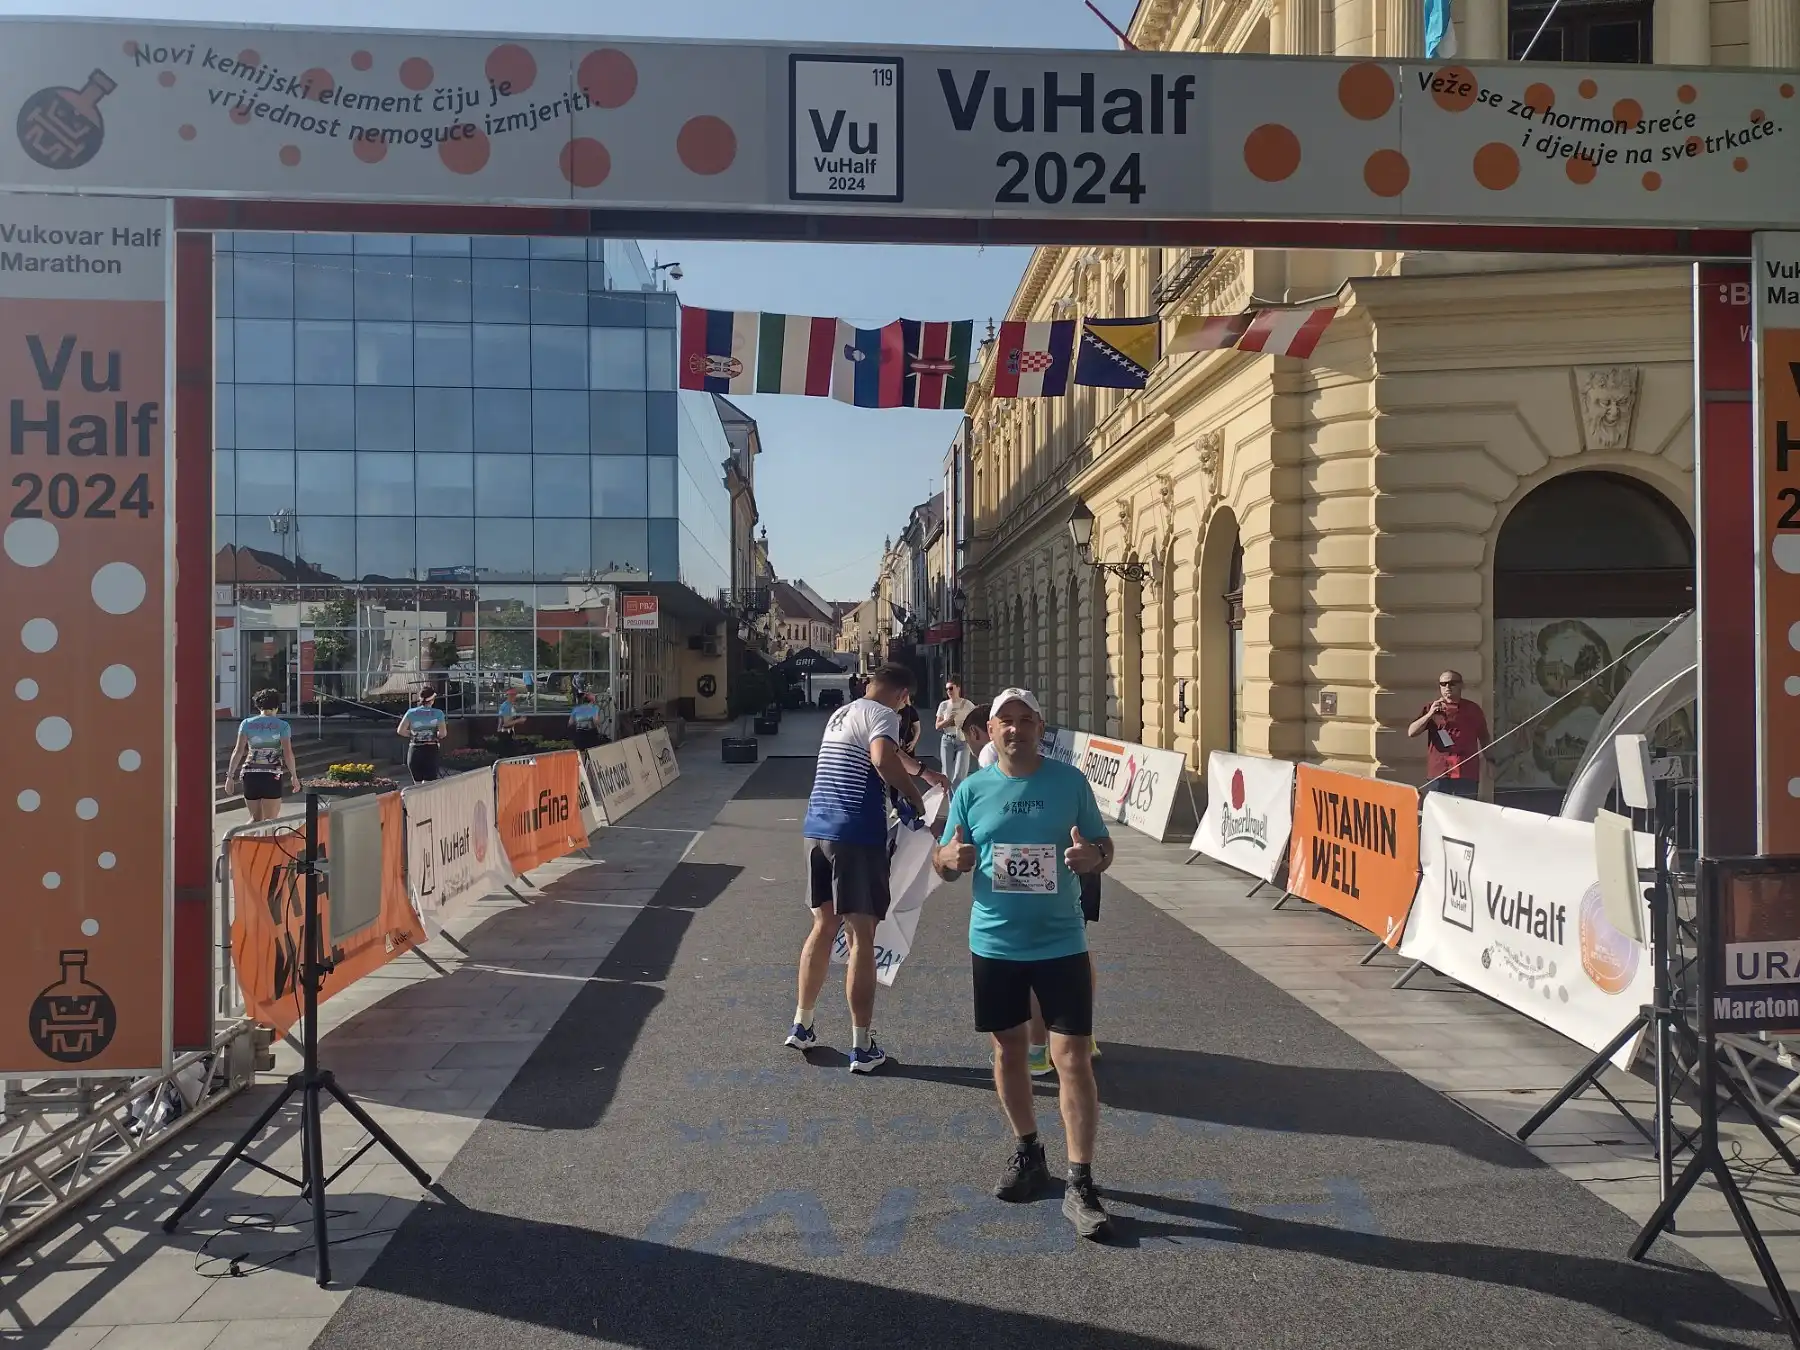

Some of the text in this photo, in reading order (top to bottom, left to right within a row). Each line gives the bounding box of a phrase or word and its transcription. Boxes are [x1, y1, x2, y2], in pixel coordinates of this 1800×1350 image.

[134, 43, 513, 118] Novi kemijski element čiju je
[872, 68, 893, 87] 119
[207, 86, 600, 149] vrijednost nemoguće izmjeriti.
[937, 68, 1196, 135] VuHalf
[1418, 71, 1697, 135] Veže se za hormon sreće
[808, 109, 878, 155] Vu
[1521, 117, 1784, 167] i djeluje na sve trkače.
[814, 157, 877, 175] VuHalf
[828, 176, 866, 191] 2024
[995, 151, 1147, 205] 2024
[0, 223, 162, 247] Vukovar Half
[0, 252, 122, 274] Marathon
[25, 334, 121, 393] Vu
[10, 399, 159, 457] Half
[10, 472, 155, 519] 2024
[795, 658, 817, 667] GRIF
[538, 788, 569, 829] Fina
[1311, 788, 1397, 860] VITAMIN
[440, 827, 470, 866] VuHalf
[1007, 859, 1041, 877] 623
[1311, 835, 1360, 900] WELL
[1450, 868, 1467, 900] Vu
[1487, 881, 1566, 946] VuHalf
[1736, 951, 1800, 981] UR
[1713, 997, 1799, 1020] Maraton
